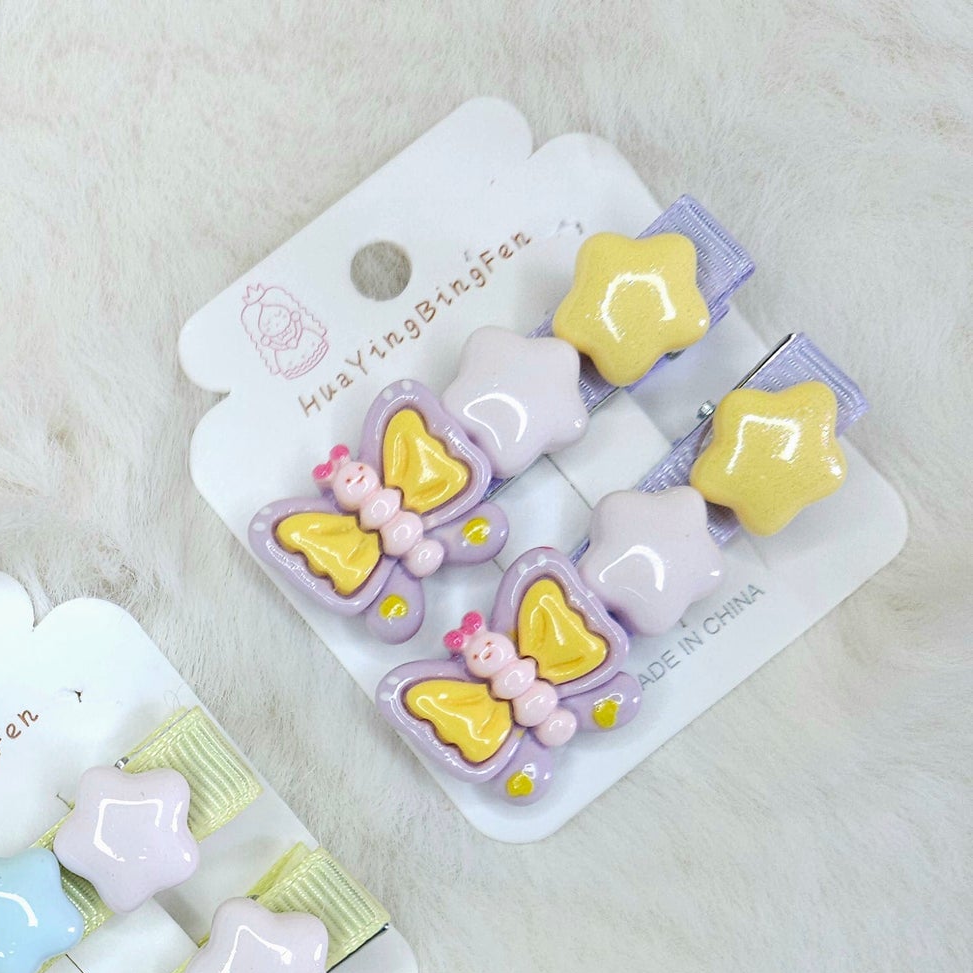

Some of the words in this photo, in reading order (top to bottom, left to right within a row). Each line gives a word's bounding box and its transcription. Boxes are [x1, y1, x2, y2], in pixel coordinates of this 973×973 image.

[297, 230, 531, 418] HuaYingBingFen
[637, 649, 682, 691] ADE
[677, 631, 704, 655] IN
[702, 584, 765, 634] CHINA
